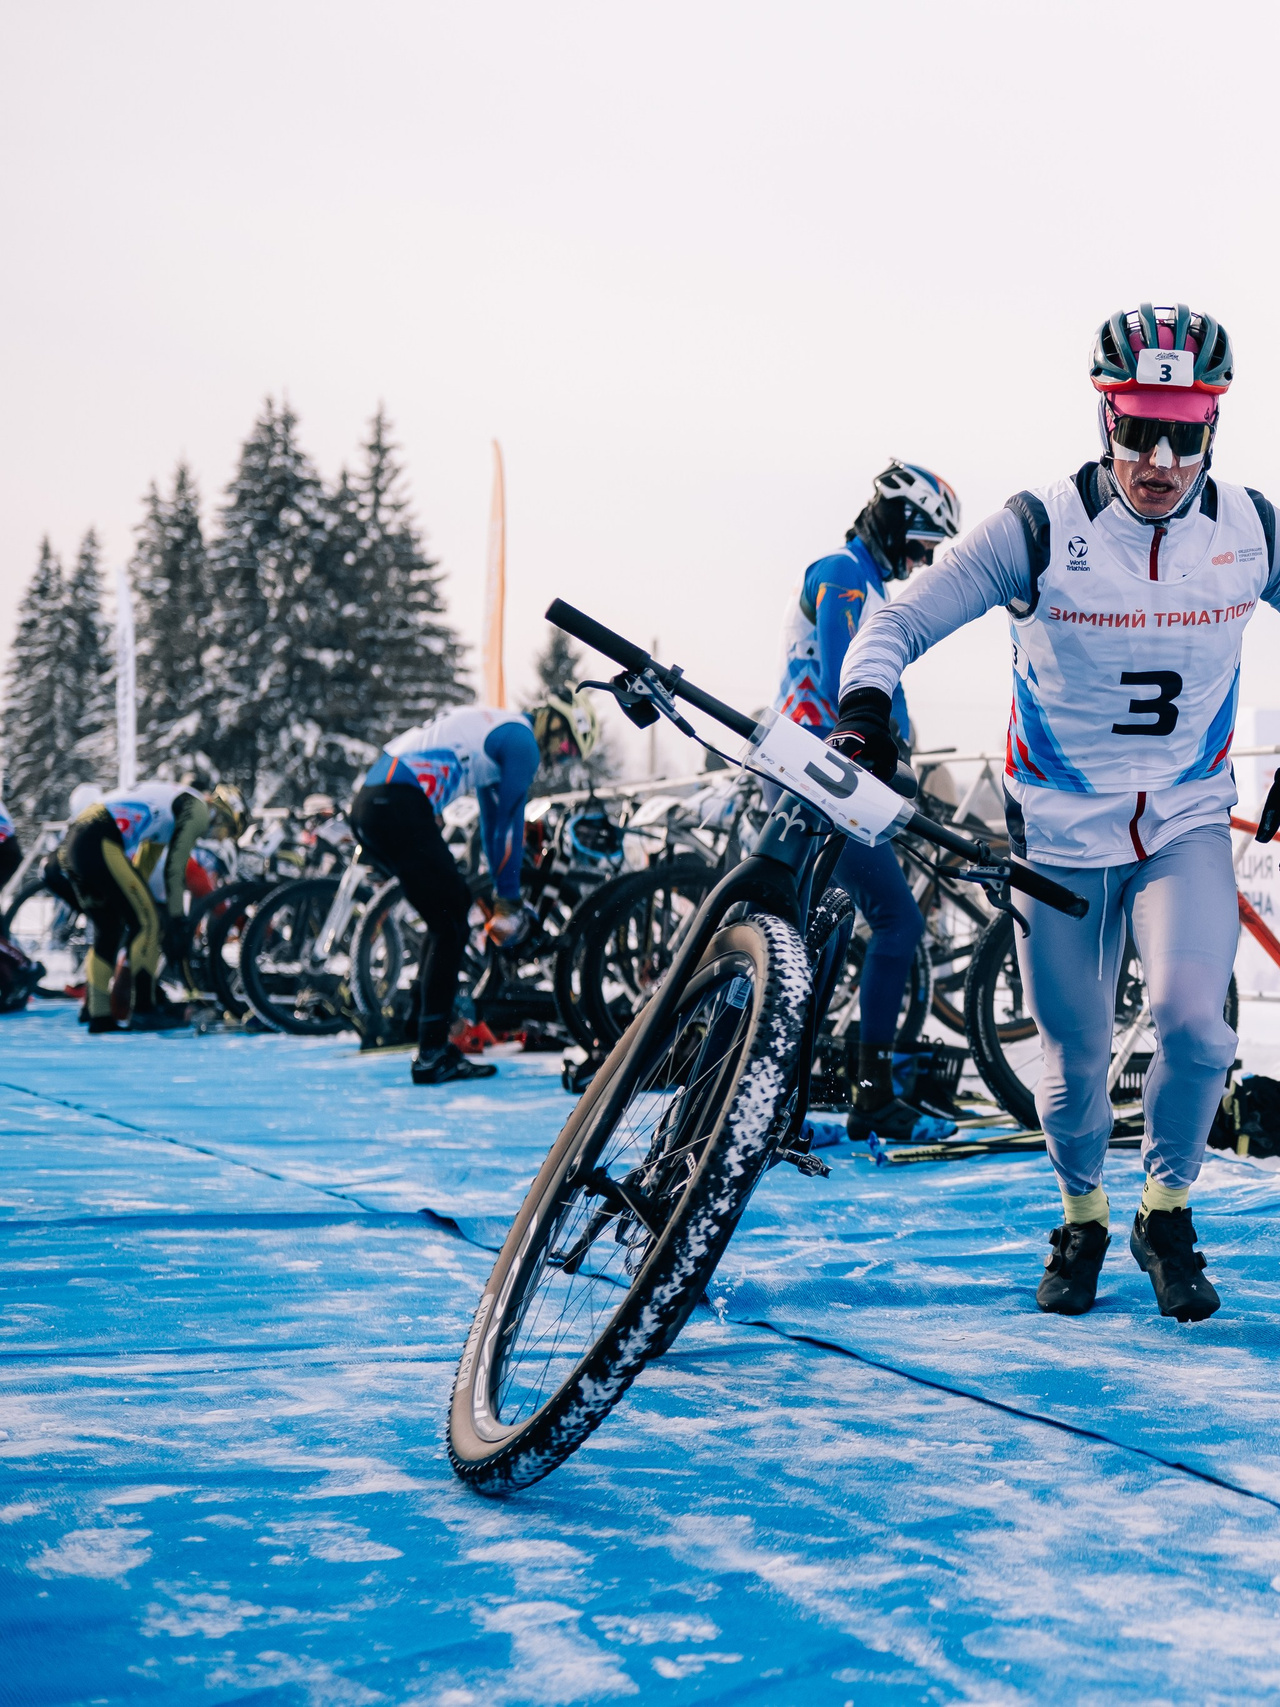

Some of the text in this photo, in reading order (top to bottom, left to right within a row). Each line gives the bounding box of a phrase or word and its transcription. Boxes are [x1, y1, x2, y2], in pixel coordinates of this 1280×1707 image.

[1159, 364, 1172, 382] 3
[1048, 600, 1255, 628] ЗИМНИЙ ТРИАТЛОН
[1111, 671, 1183, 736] 3
[459, 1303, 489, 1383] FAST TRAK
